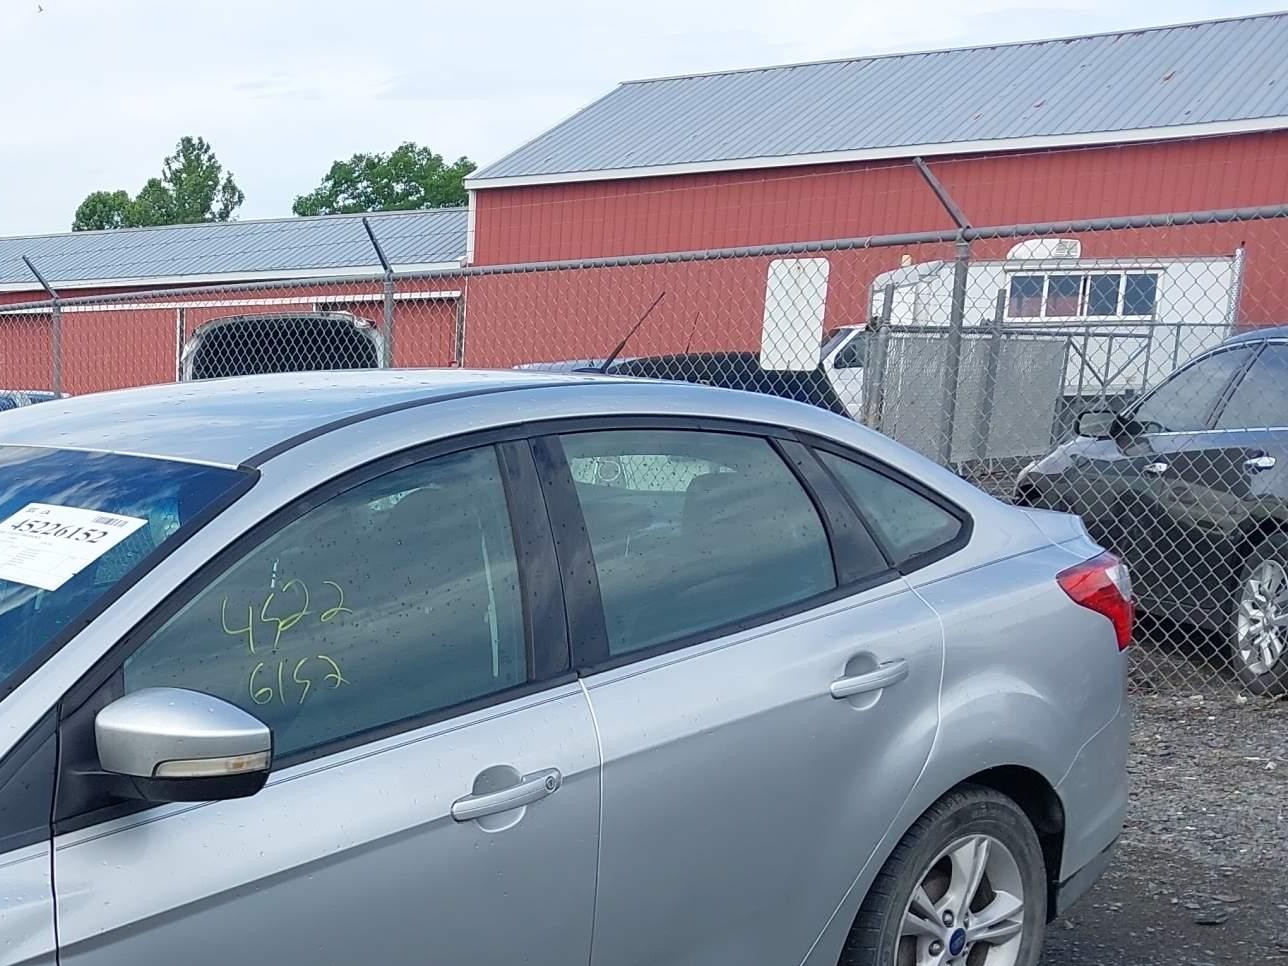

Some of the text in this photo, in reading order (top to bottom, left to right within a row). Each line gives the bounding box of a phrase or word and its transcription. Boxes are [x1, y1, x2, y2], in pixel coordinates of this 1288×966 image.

[11, 519, 108, 544] 45226152
[221, 578, 353, 655] 4522
[248, 654, 351, 705] 6152
